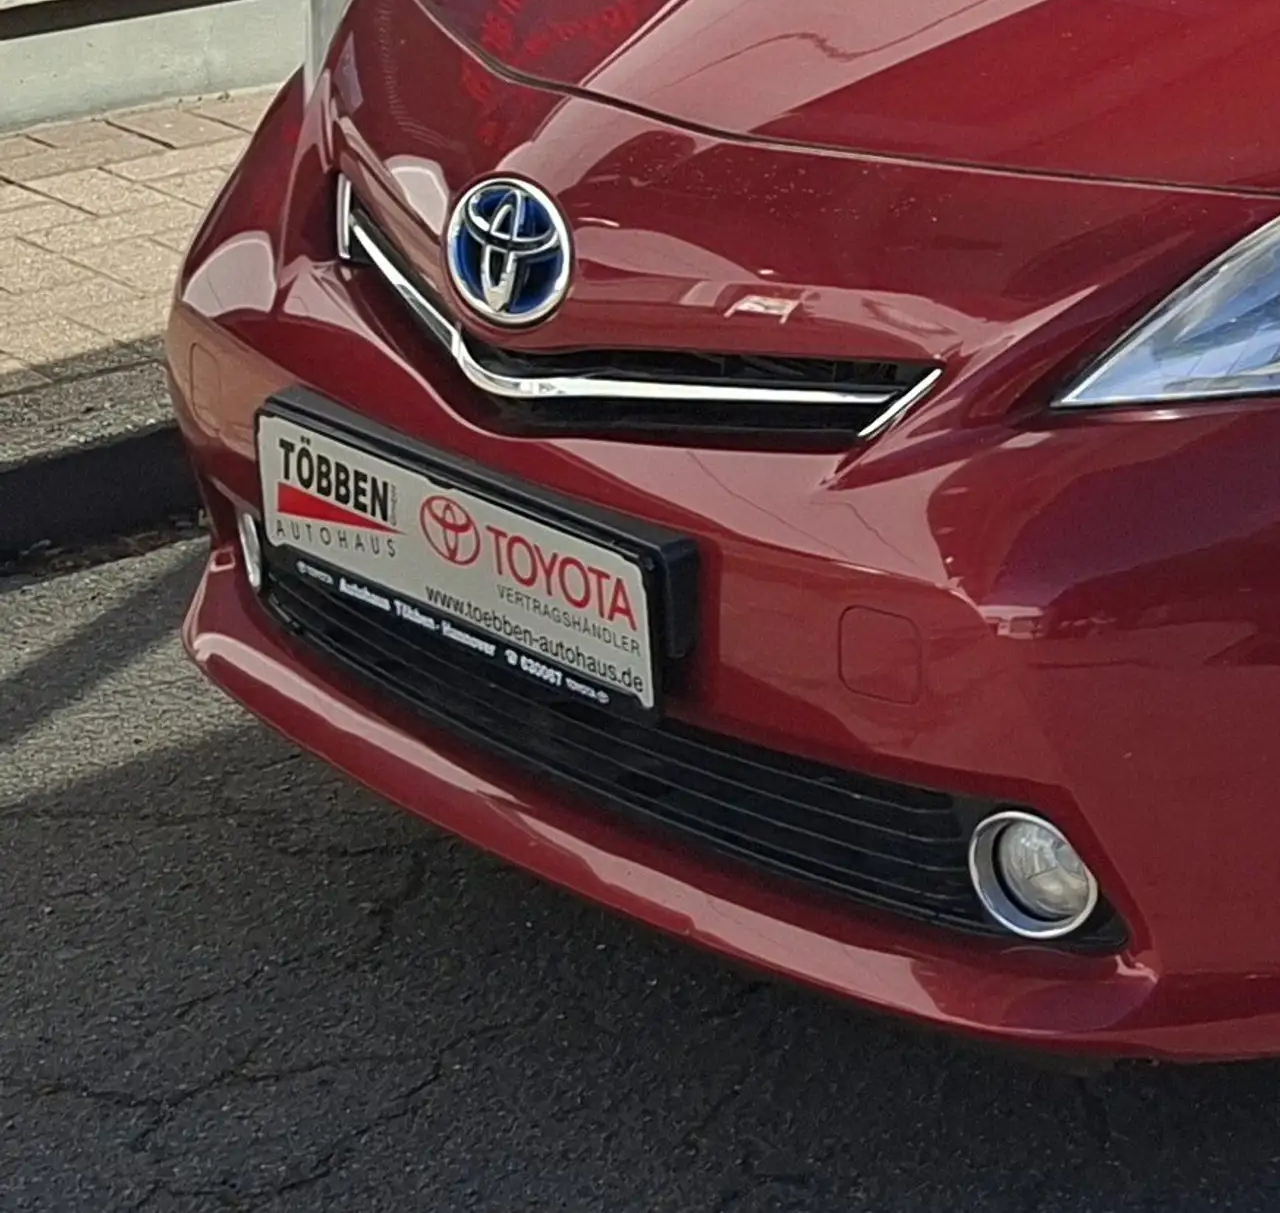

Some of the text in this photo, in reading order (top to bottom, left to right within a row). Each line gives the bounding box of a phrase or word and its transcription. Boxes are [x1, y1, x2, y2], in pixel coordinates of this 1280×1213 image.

[279, 436, 389, 522] TÖBBEN
[276, 519, 397, 558] AUTOHAUS
[486, 525, 638, 632] TOYOTA
[425, 586, 644, 693] www.toebben-autohaus.de
